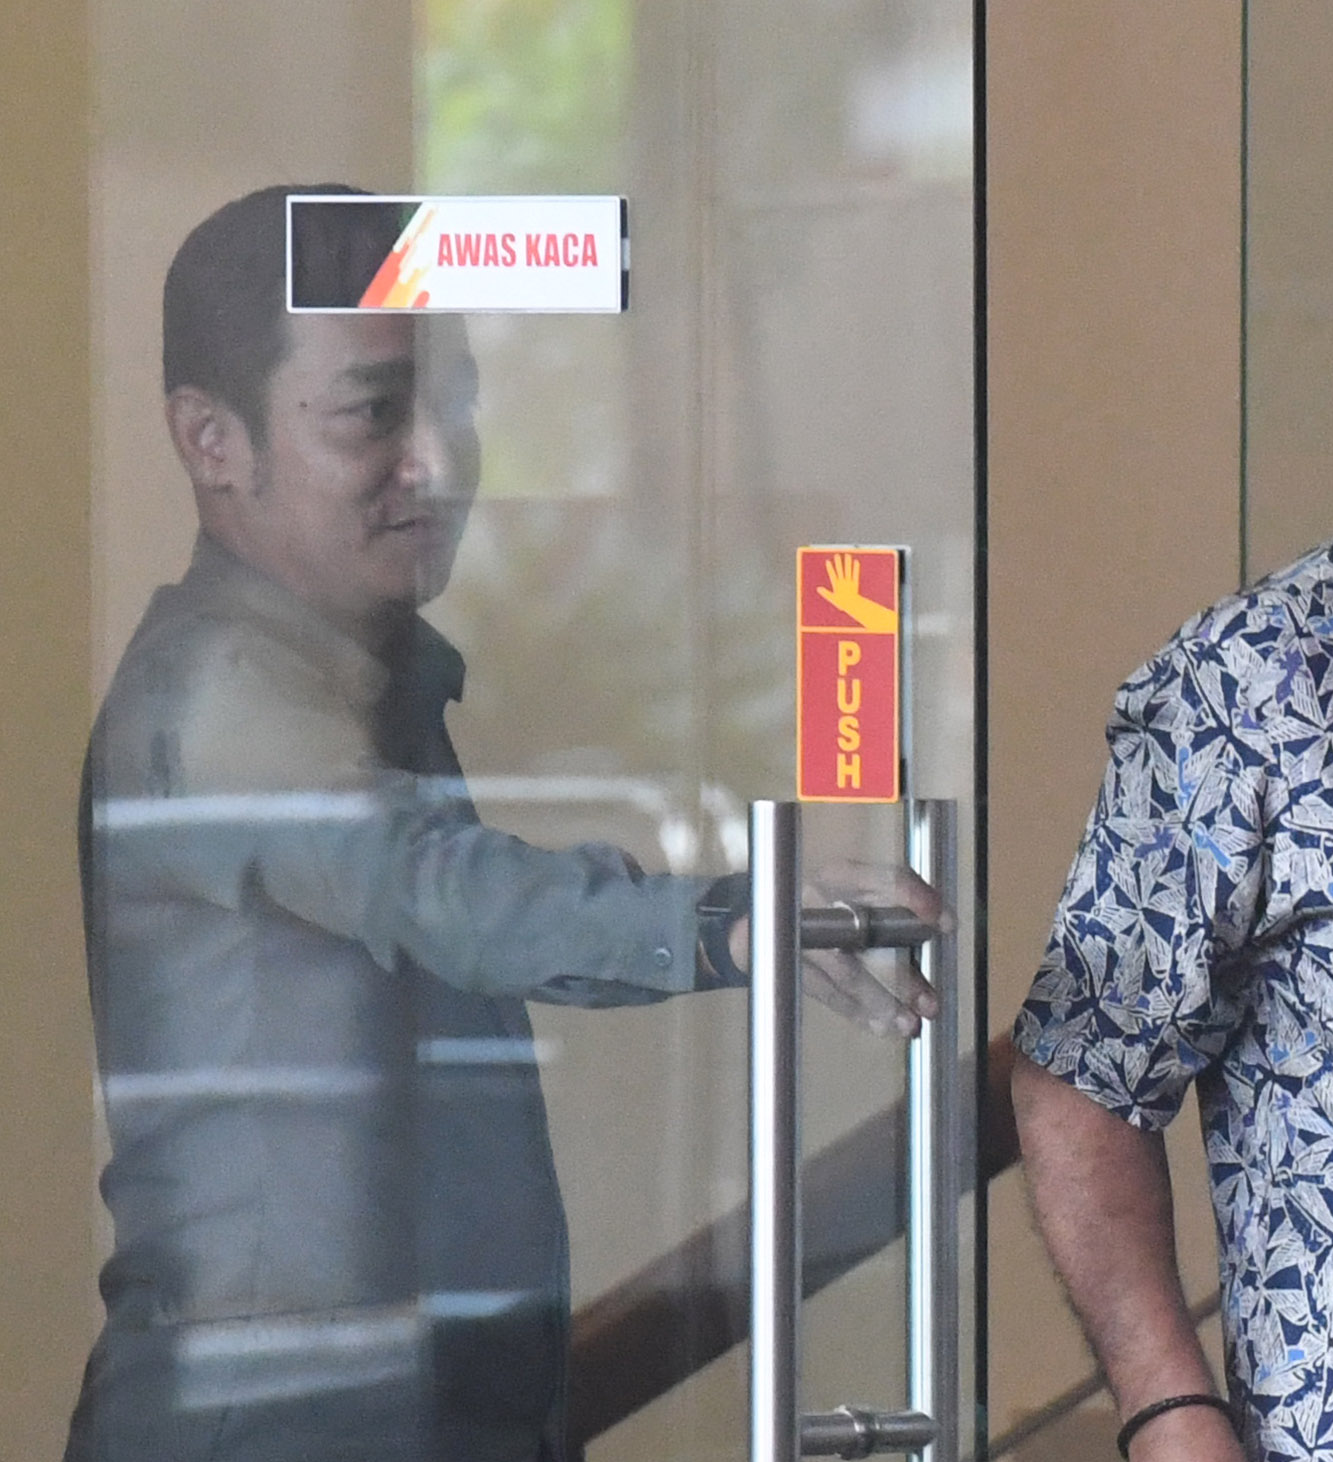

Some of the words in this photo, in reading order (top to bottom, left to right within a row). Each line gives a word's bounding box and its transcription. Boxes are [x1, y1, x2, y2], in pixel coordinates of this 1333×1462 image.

[437, 232, 517, 267] AWAS
[525, 232, 599, 268] KACA
[836, 640, 862, 789] PUSH
